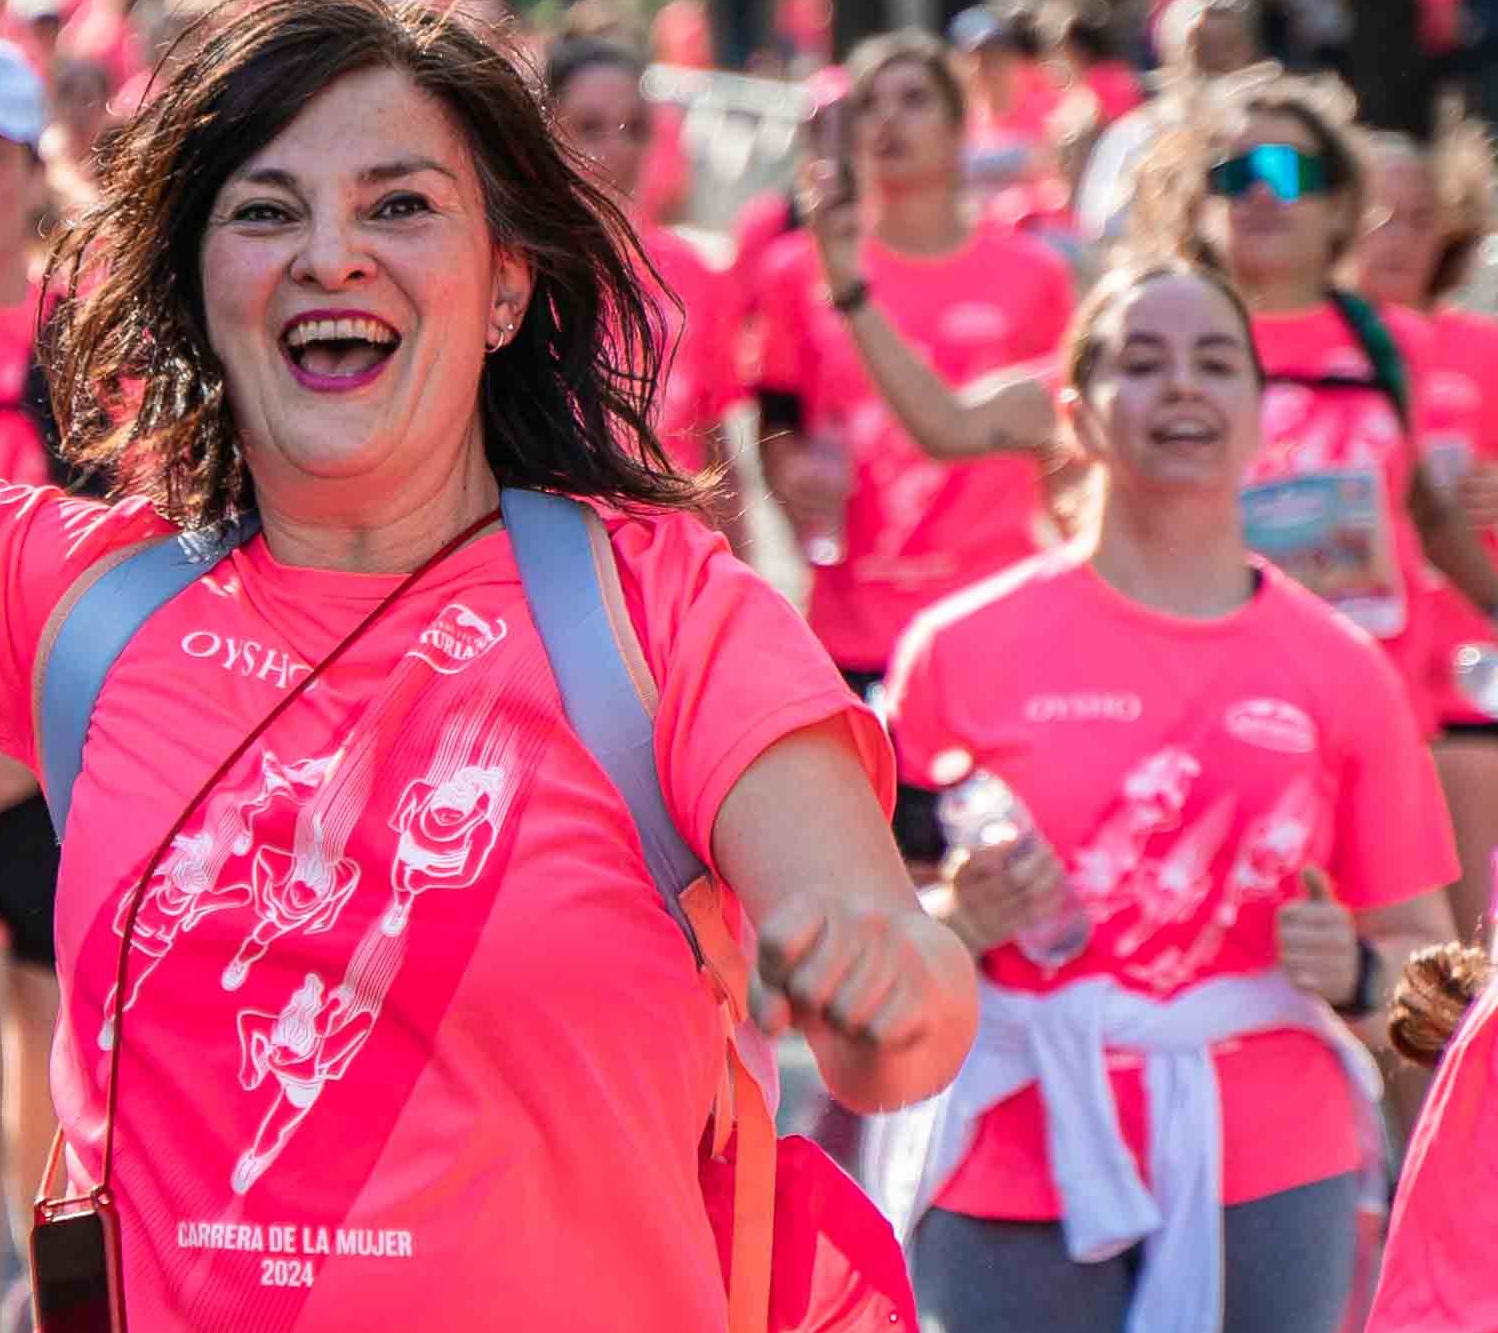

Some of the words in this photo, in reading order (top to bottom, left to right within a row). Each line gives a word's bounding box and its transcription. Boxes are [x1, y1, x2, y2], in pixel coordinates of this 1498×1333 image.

[177, 1221, 263, 1251] CARRERA
[268, 1225, 296, 1253] DE
[302, 1226, 330, 1255] LA
[335, 1229, 413, 1257] MUJER
[261, 1259, 314, 1287] 2024
